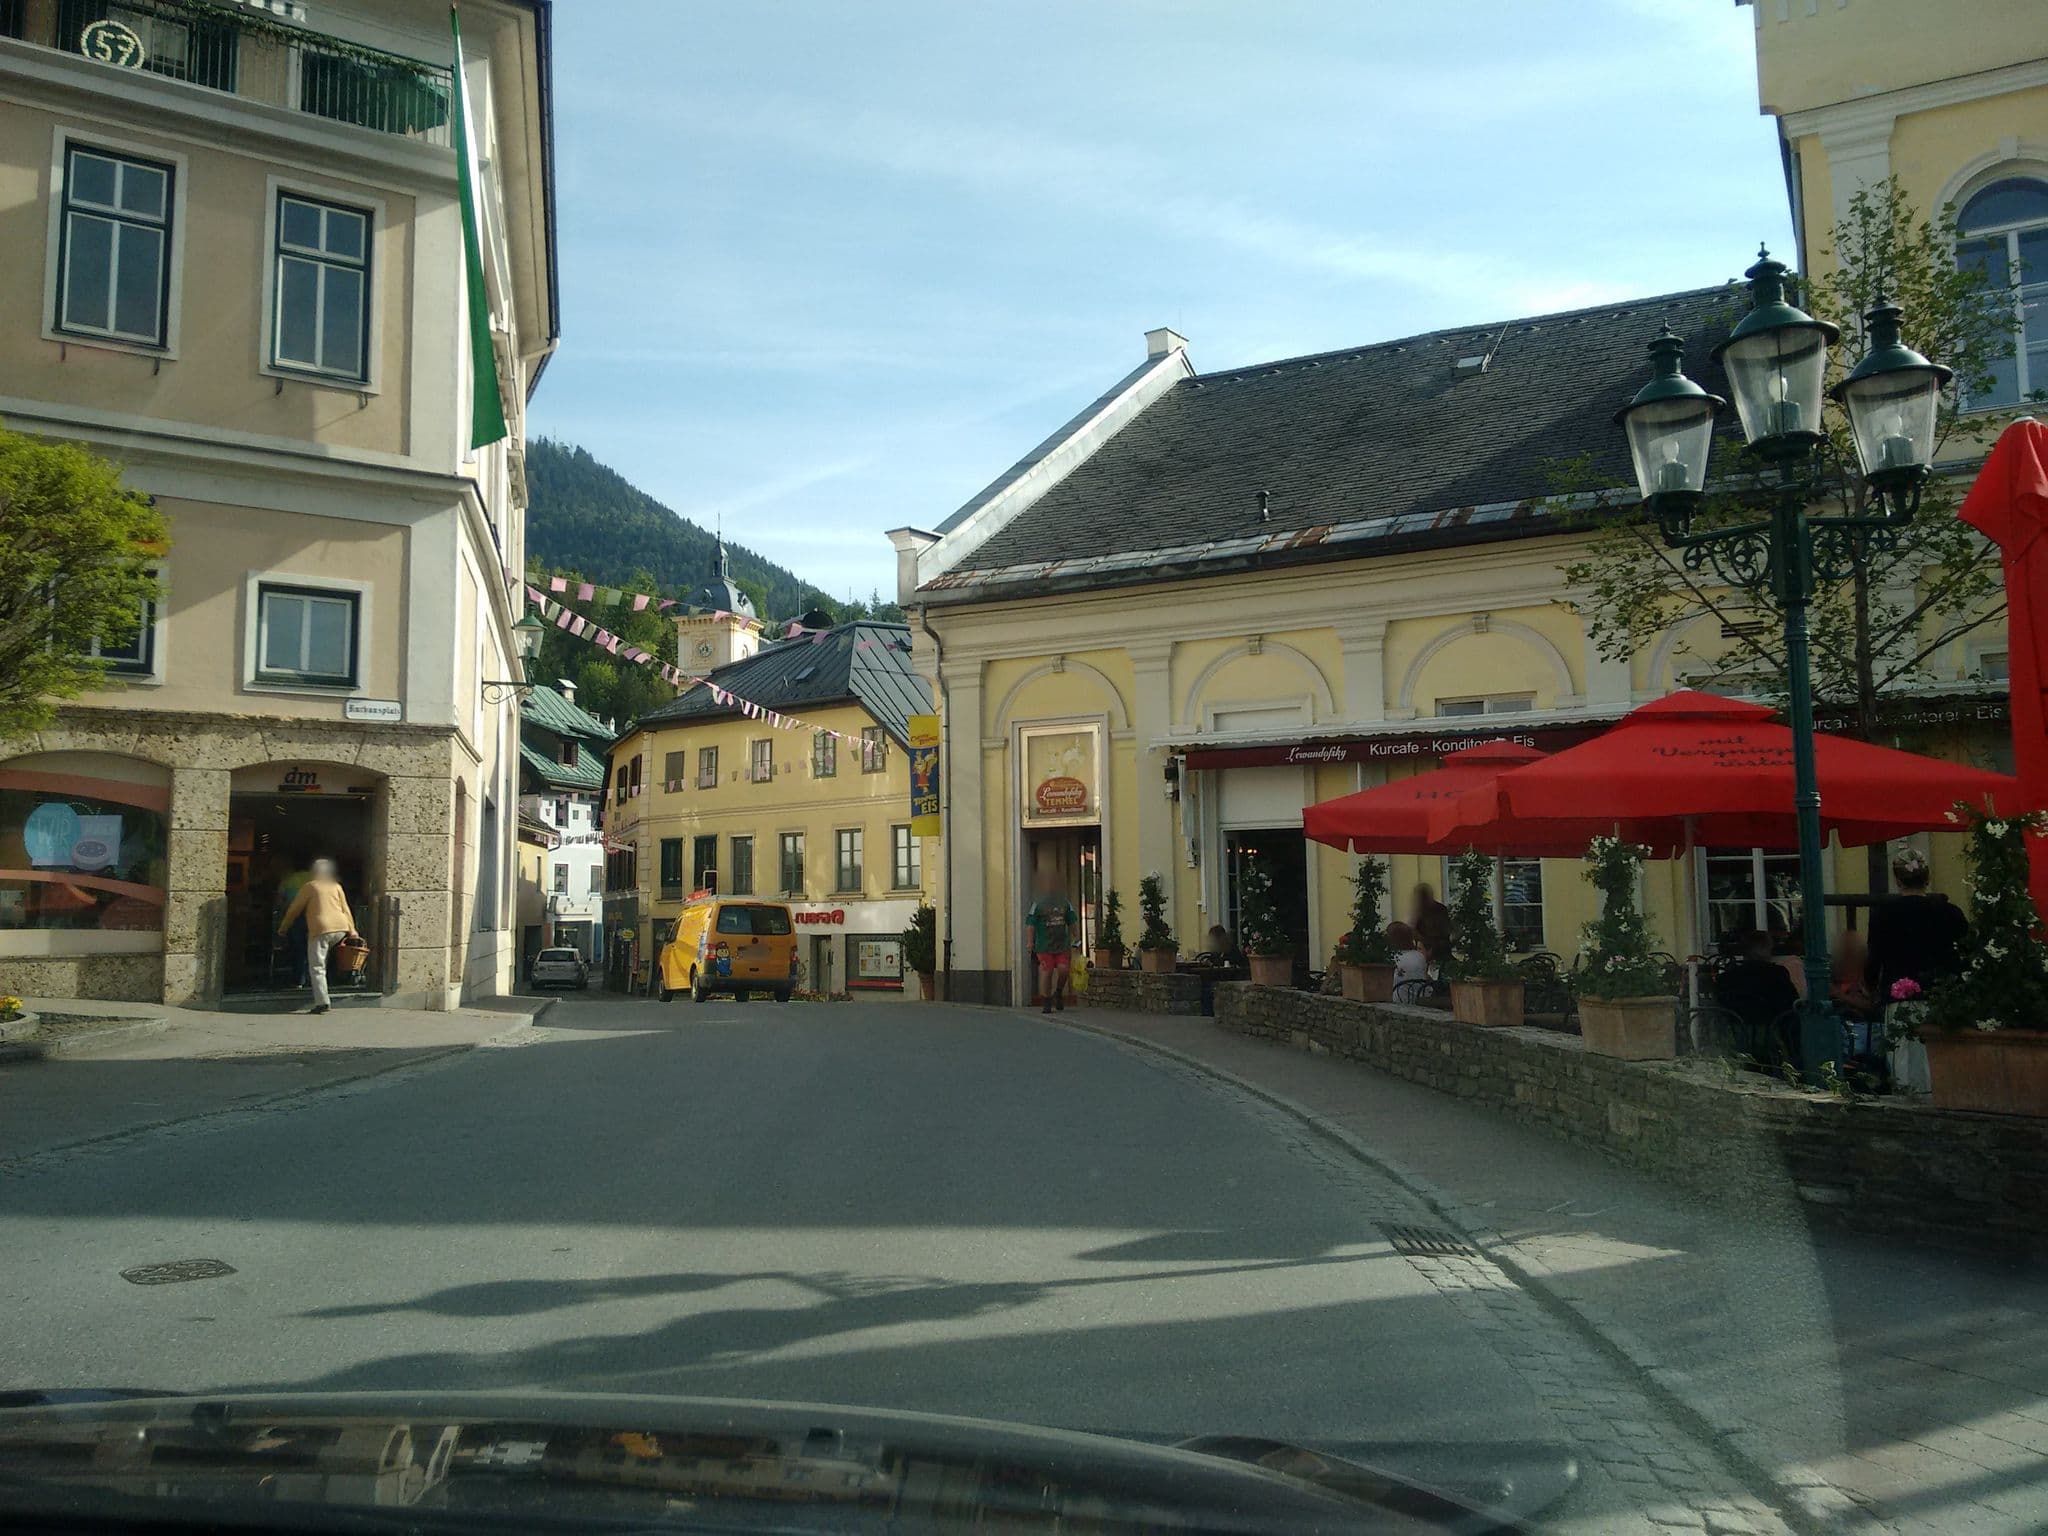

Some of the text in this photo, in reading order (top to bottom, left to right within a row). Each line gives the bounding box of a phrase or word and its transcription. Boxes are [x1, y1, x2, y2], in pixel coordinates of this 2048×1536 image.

[95, 29, 137, 65] 57
[1369, 741, 1420, 756] Kurcafe
[284, 766, 317, 785] dm
[921, 800, 938, 814] EIS
